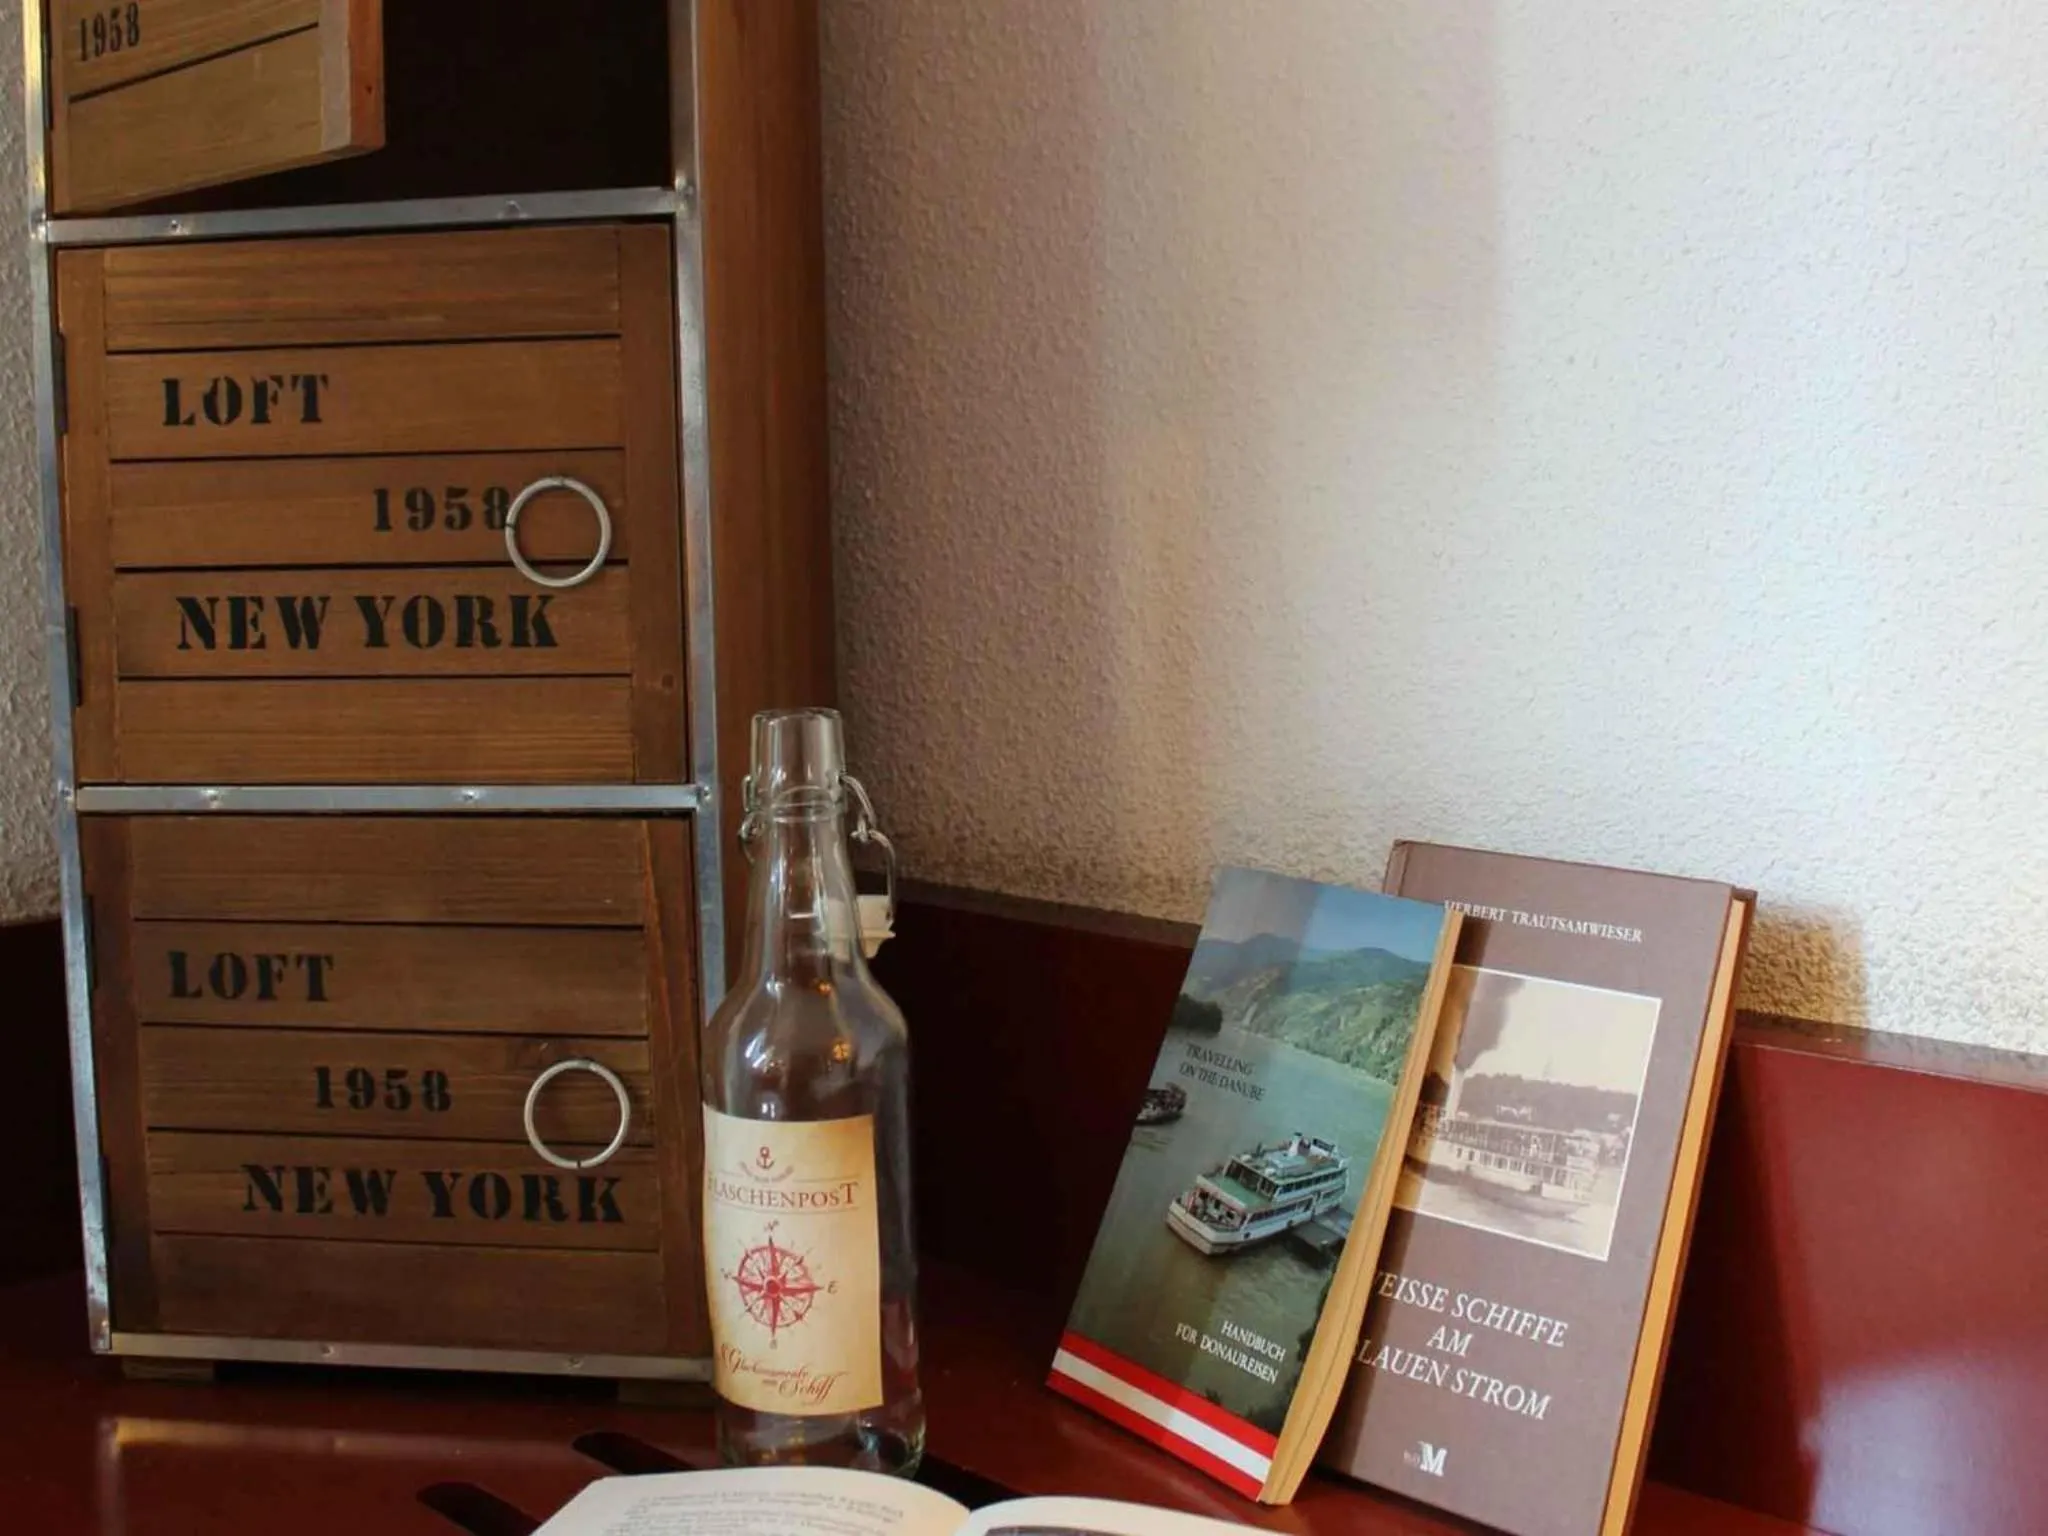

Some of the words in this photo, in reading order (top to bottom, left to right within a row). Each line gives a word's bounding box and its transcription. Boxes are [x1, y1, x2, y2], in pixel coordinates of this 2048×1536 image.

[80, 2, 140, 61] 1958
[161, 374, 329, 428] LOFT
[373, 486, 510, 532] 1958
[177, 595, 330, 650] NEW
[354, 593, 558, 650] YORK
[1512, 910, 1643, 943] TRAUTSAMWIESER
[167, 950, 334, 1003] LOFT
[313, 1066, 452, 1112] 1958
[242, 1164, 396, 1219] NEW
[421, 1171, 625, 1225] YORK
[1378, 1270, 1449, 1313] EISSE
[1451, 1293, 1568, 1348] SCHIFFE
[1200, 1334, 1279, 1384] DONAUREISEN
[1221, 1320, 1286, 1362] HANDBUCH
[1426, 1325, 1473, 1357] AM
[1451, 1368, 1552, 1420] STROM
